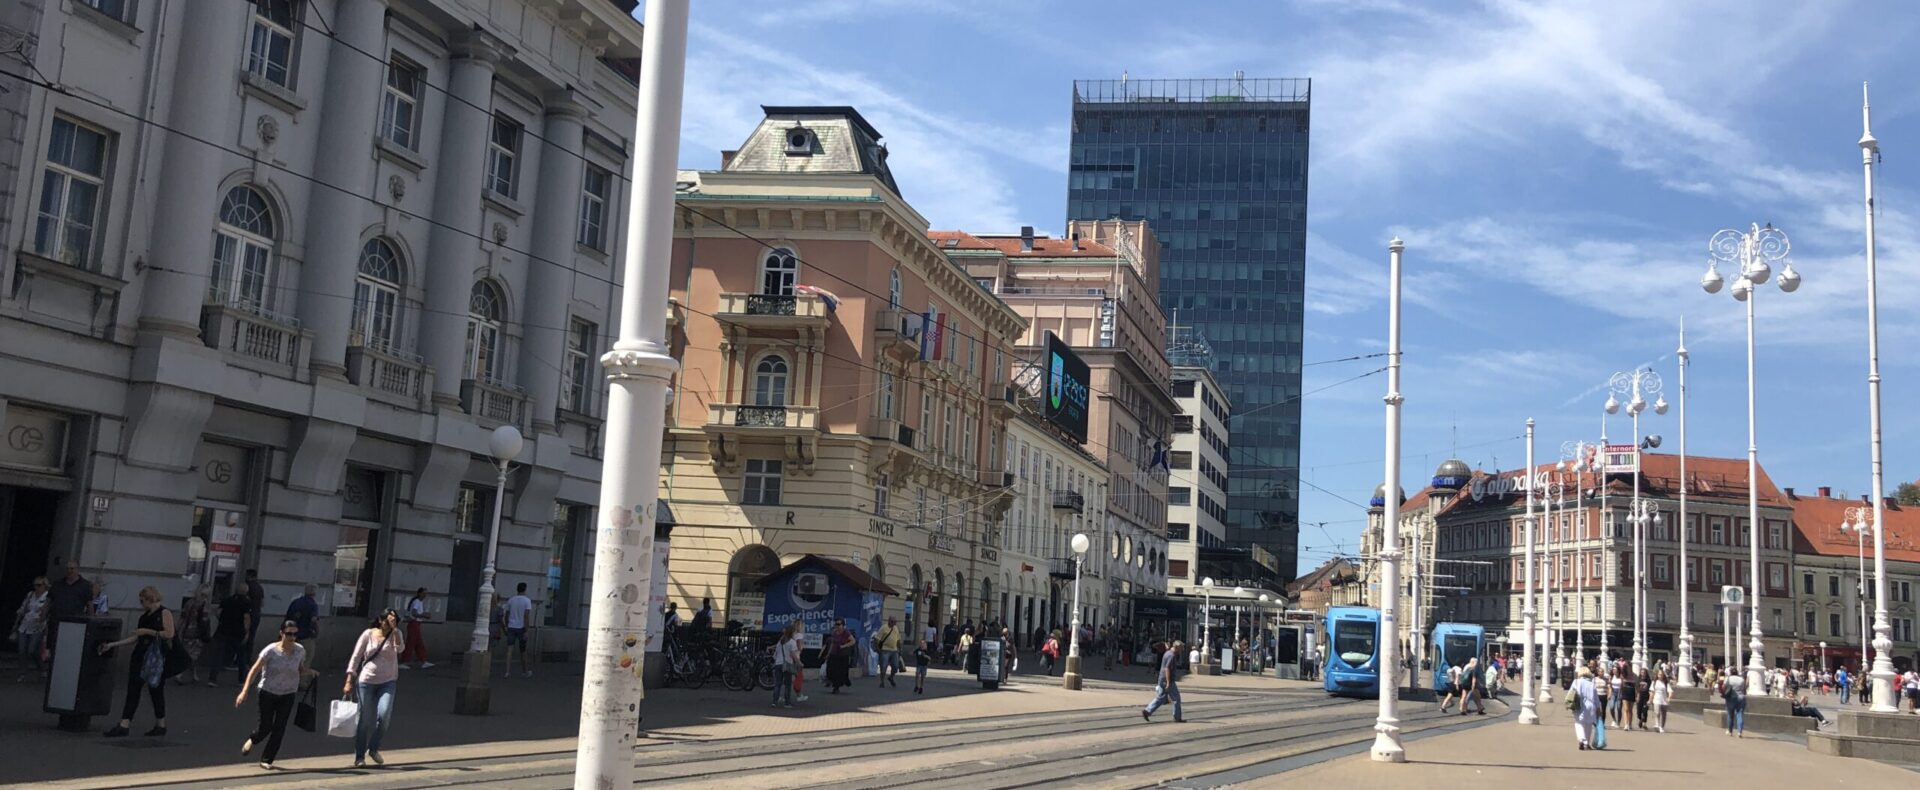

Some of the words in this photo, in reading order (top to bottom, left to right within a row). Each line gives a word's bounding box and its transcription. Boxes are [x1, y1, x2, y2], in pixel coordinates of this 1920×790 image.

[1487, 466, 1549, 500] otpbaka
[868, 518, 894, 537] SINGER
[981, 548, 998, 562] SINGER
[767, 609, 834, 624] Experience
[820, 618, 847, 632] cit!
